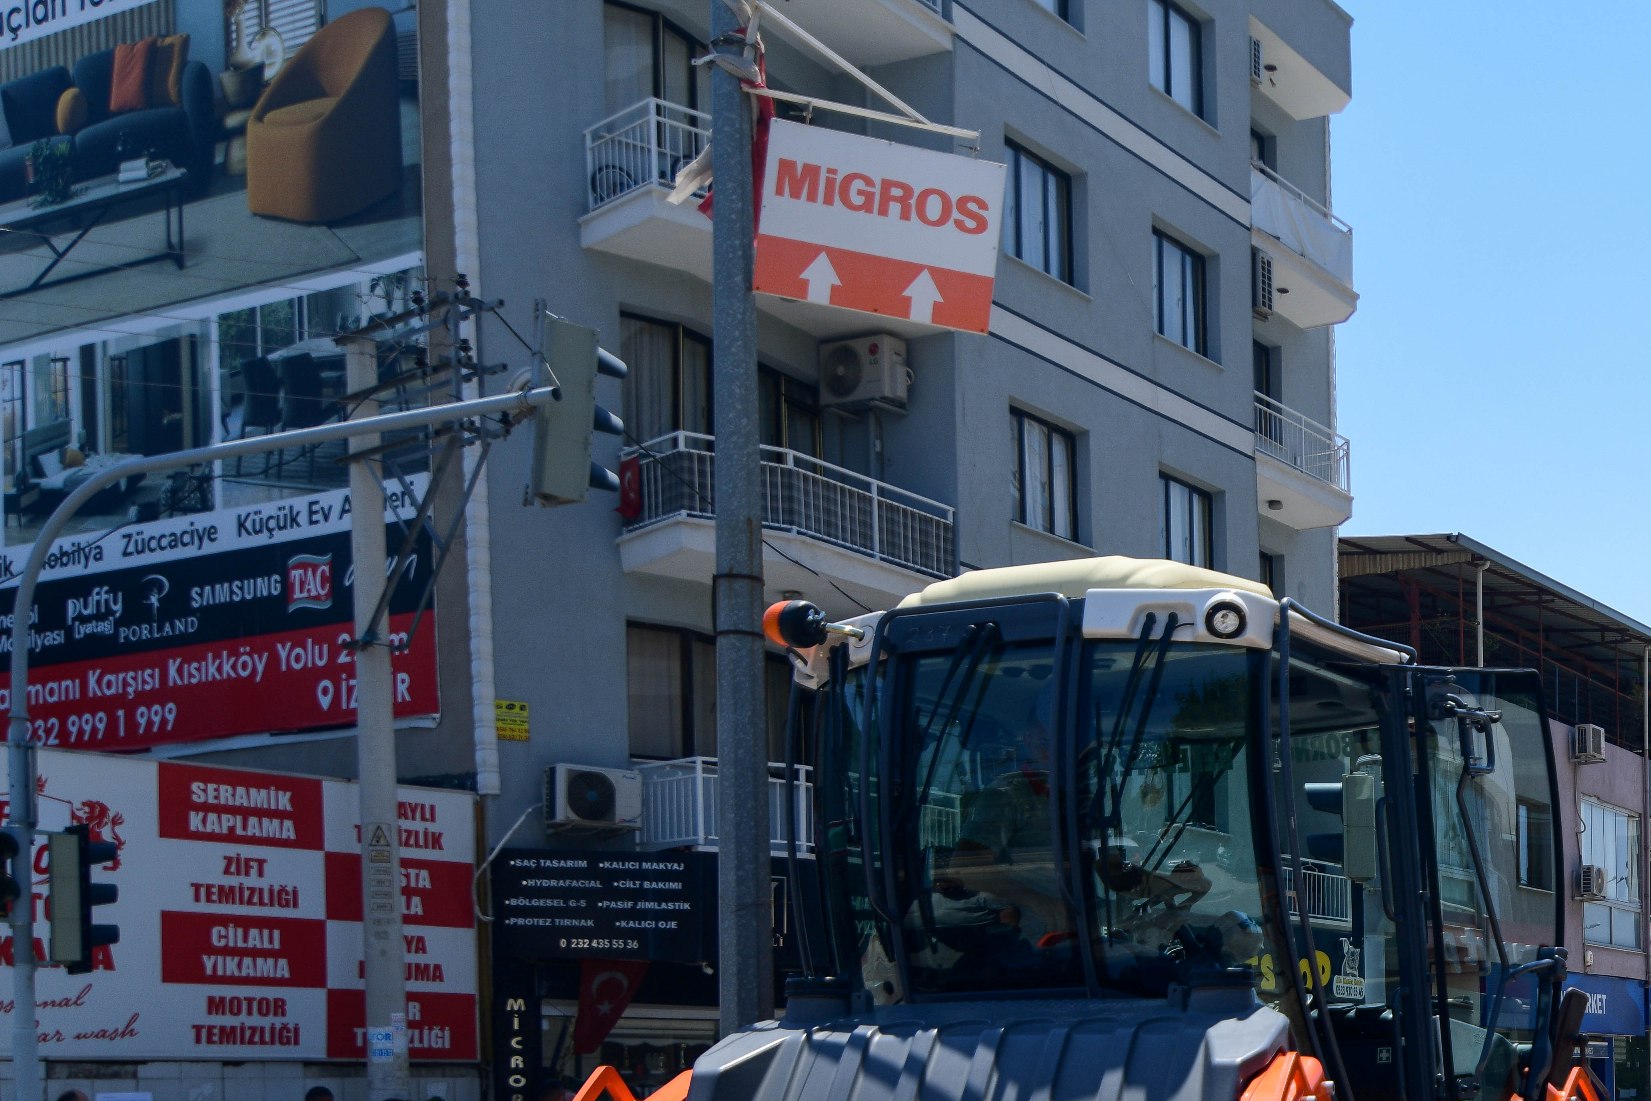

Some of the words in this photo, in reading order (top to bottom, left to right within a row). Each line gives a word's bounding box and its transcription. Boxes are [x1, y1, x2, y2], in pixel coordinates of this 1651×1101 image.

[43, 541, 104, 570] obilya
[122, 521, 219, 558] Züccaciye
[238, 505, 303, 539] Küçük
[309, 500, 333, 526] Ev
[67, 586, 123, 626] puffy
[190, 574, 282, 609] SAMSUNG
[118, 617, 199, 643] PORLAND
[88, 668, 160, 701] Karşısı
[168, 646, 269, 688] Kısıkköy
[277, 638, 331, 673] Yolu
[342, 672, 412, 711] İZR
[67, 711, 108, 744] 999
[116, 709, 126, 738] 1
[137, 702, 178, 735] 999
[191, 781, 295, 812] SERAMİK
[190, 810, 297, 841] KAPLAMA
[354, 822, 445, 851] TZLİK
[223, 853, 268, 879] ZİFT
[515, 859, 538, 870] SAÇ
[540, 860, 588, 870] TASARIM
[604, 861, 640, 872] KALICI
[642, 862, 685, 873] MAKYAJ
[191, 882, 300, 910] TEMİZLİĞİ
[527, 880, 604, 890] HYDRAFACIAL
[620, 879, 642, 891] CİLT
[643, 881, 683, 892] BAKIMI
[510, 896, 567, 908] BÖLGESEL
[603, 900, 635, 911] PASİF
[636, 901, 692, 912] JİMLASTİK
[510, 919, 553, 928] PROTEZ
[555, 920, 595, 929] TIRNAK
[620, 922, 656, 931] KALICI
[658, 922, 680, 931] OJE
[212, 923, 281, 951] CİLALI
[559, 938, 568, 950] 0
[571, 938, 590, 950] 232
[591, 938, 611, 950] 435
[613, 938, 625, 950] 55
[626, 938, 640, 951] 36
[202, 954, 291, 979] YIKAMA
[208, 995, 288, 1018] MOTOR
[192, 1021, 301, 1046] TEMİZLİĞİ
[353, 1025, 452, 1049] TZLİĞİ
